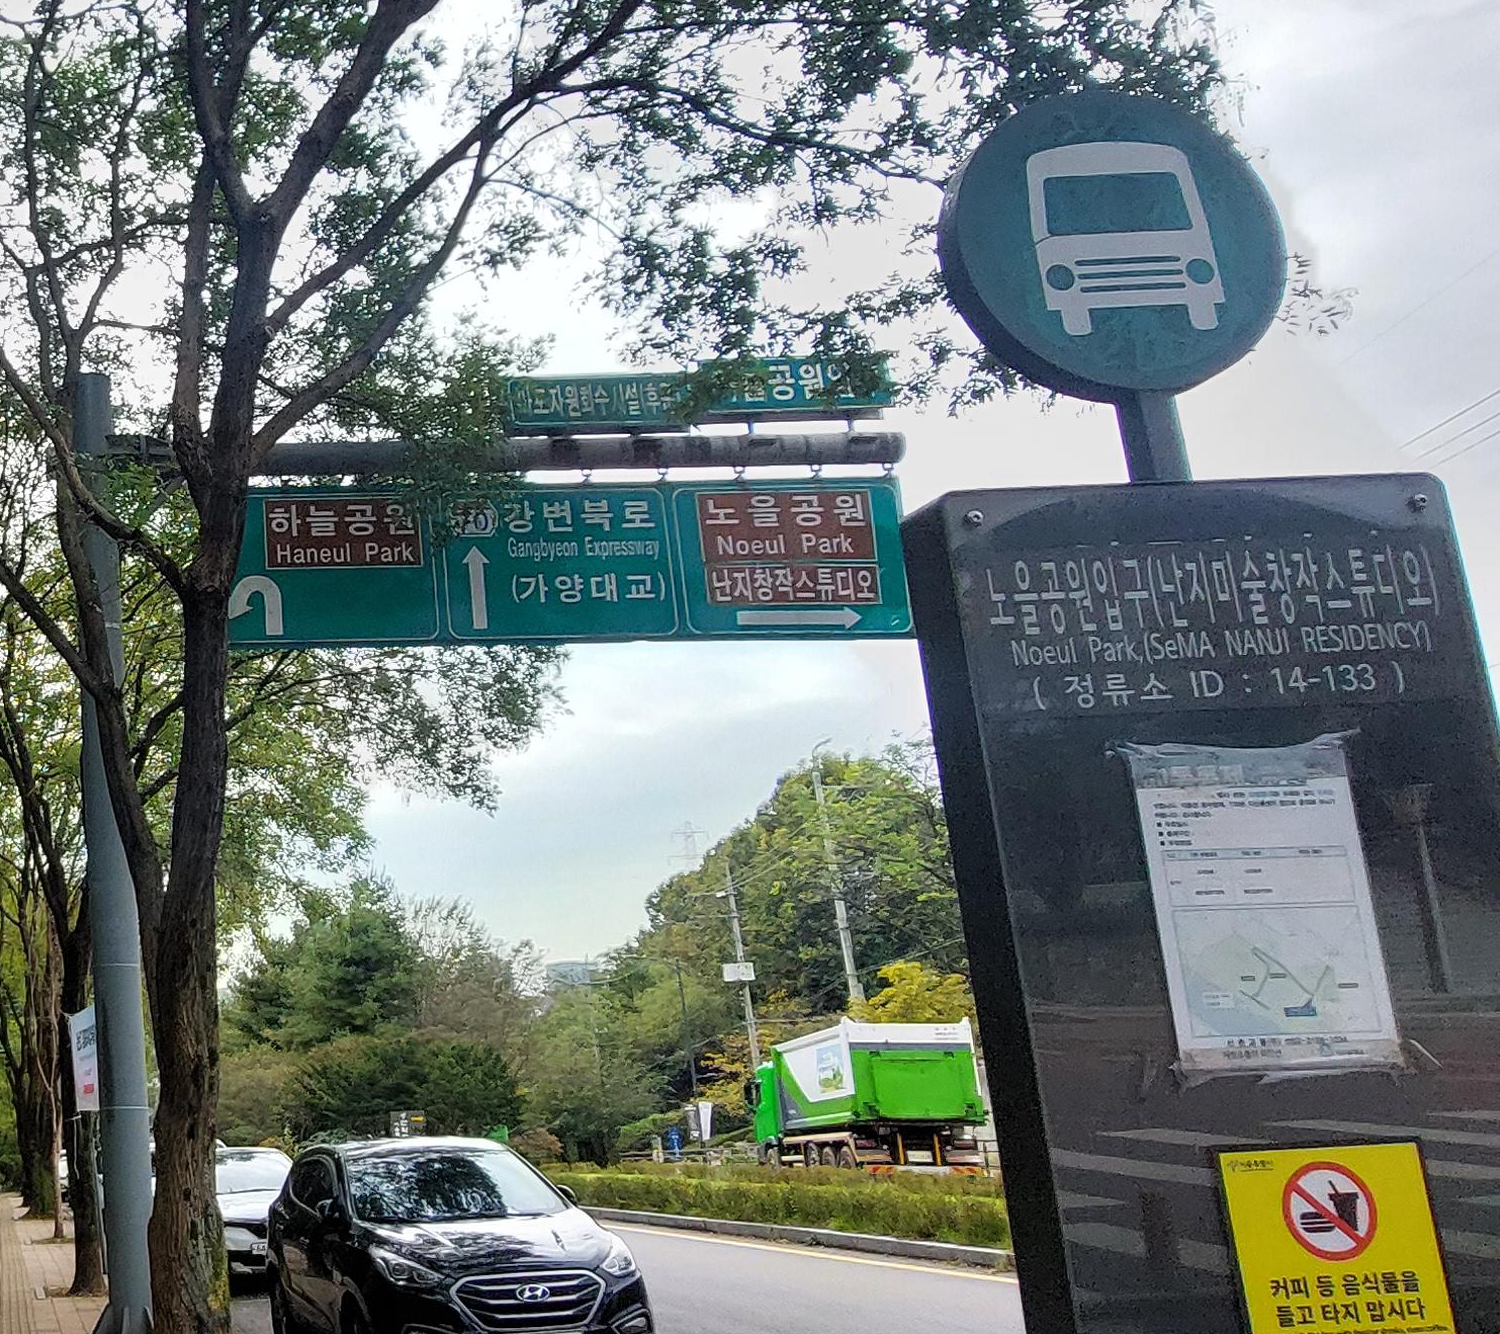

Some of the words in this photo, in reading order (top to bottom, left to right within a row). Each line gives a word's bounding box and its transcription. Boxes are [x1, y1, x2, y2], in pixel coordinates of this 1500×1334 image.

[268, 504, 415, 537] 하늘공원
[503, 499, 656, 533] 강변북로
[705, 494, 867, 527] 노을공원
[276, 543, 351, 564] Haneul
[364, 542, 415, 563] Park
[507, 536, 579, 562] Gangbyeon
[584, 536, 660, 561] Expressway
[717, 534, 786, 556] Noeul
[801, 533, 855, 555] Park
[512, 571, 666, 603] (가양대교)
[711, 568, 876, 602] 난지창작스튜디오
[1011, 636, 1078, 667] Noeul
[1224, 626, 1290, 658] NANJI
[1300, 618, 1433, 653] RESIDENCY)
[1063, 673, 1174, 709] 정류소
[1189, 669, 1225, 698] ID
[1270, 663, 1376, 695] 14-133
[1270, 1275, 1310, 1300] 커피
[1315, 1275, 1336, 1298] 등
[1341, 1270, 1421, 1296] 음식물을
[1276, 1304, 1317, 1328] 들고
[1321, 1301, 1361, 1325] 타지
[1366, 1297, 1426, 1323] 맙시다
